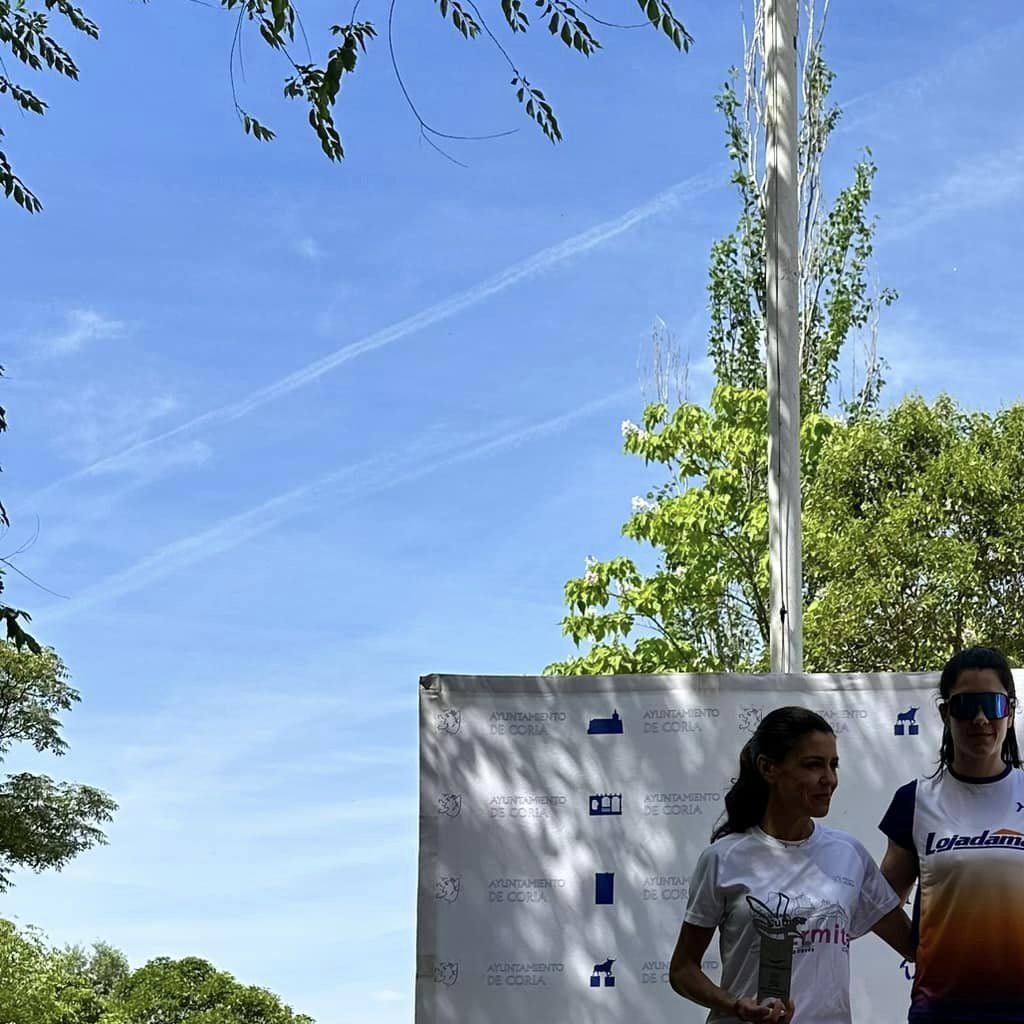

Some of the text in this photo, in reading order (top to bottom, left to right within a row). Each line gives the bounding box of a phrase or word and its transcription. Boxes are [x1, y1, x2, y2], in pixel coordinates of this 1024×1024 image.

[489, 711, 566, 722] AYUNTAMIENTO
[643, 709, 720, 719] AYUNTAMIENTO
[489, 725, 547, 736] DE CORIA
[643, 722, 702, 733] DE CORIA
[489, 796, 567, 806] AYUNTAMIENTO
[644, 793, 720, 803] AYUNTAMIENTO
[490, 807, 548, 818] DE CORIA
[644, 804, 702, 816] DE CORIA
[489, 878, 566, 889] AYUNTAMIENTO
[489, 891, 546, 902] DE CORIA
[643, 889, 657, 900] DE
[487, 963, 564, 973] AYUNTAMIENTO
[487, 975, 546, 986] DE CORIA
[642, 973, 655, 984] DE
